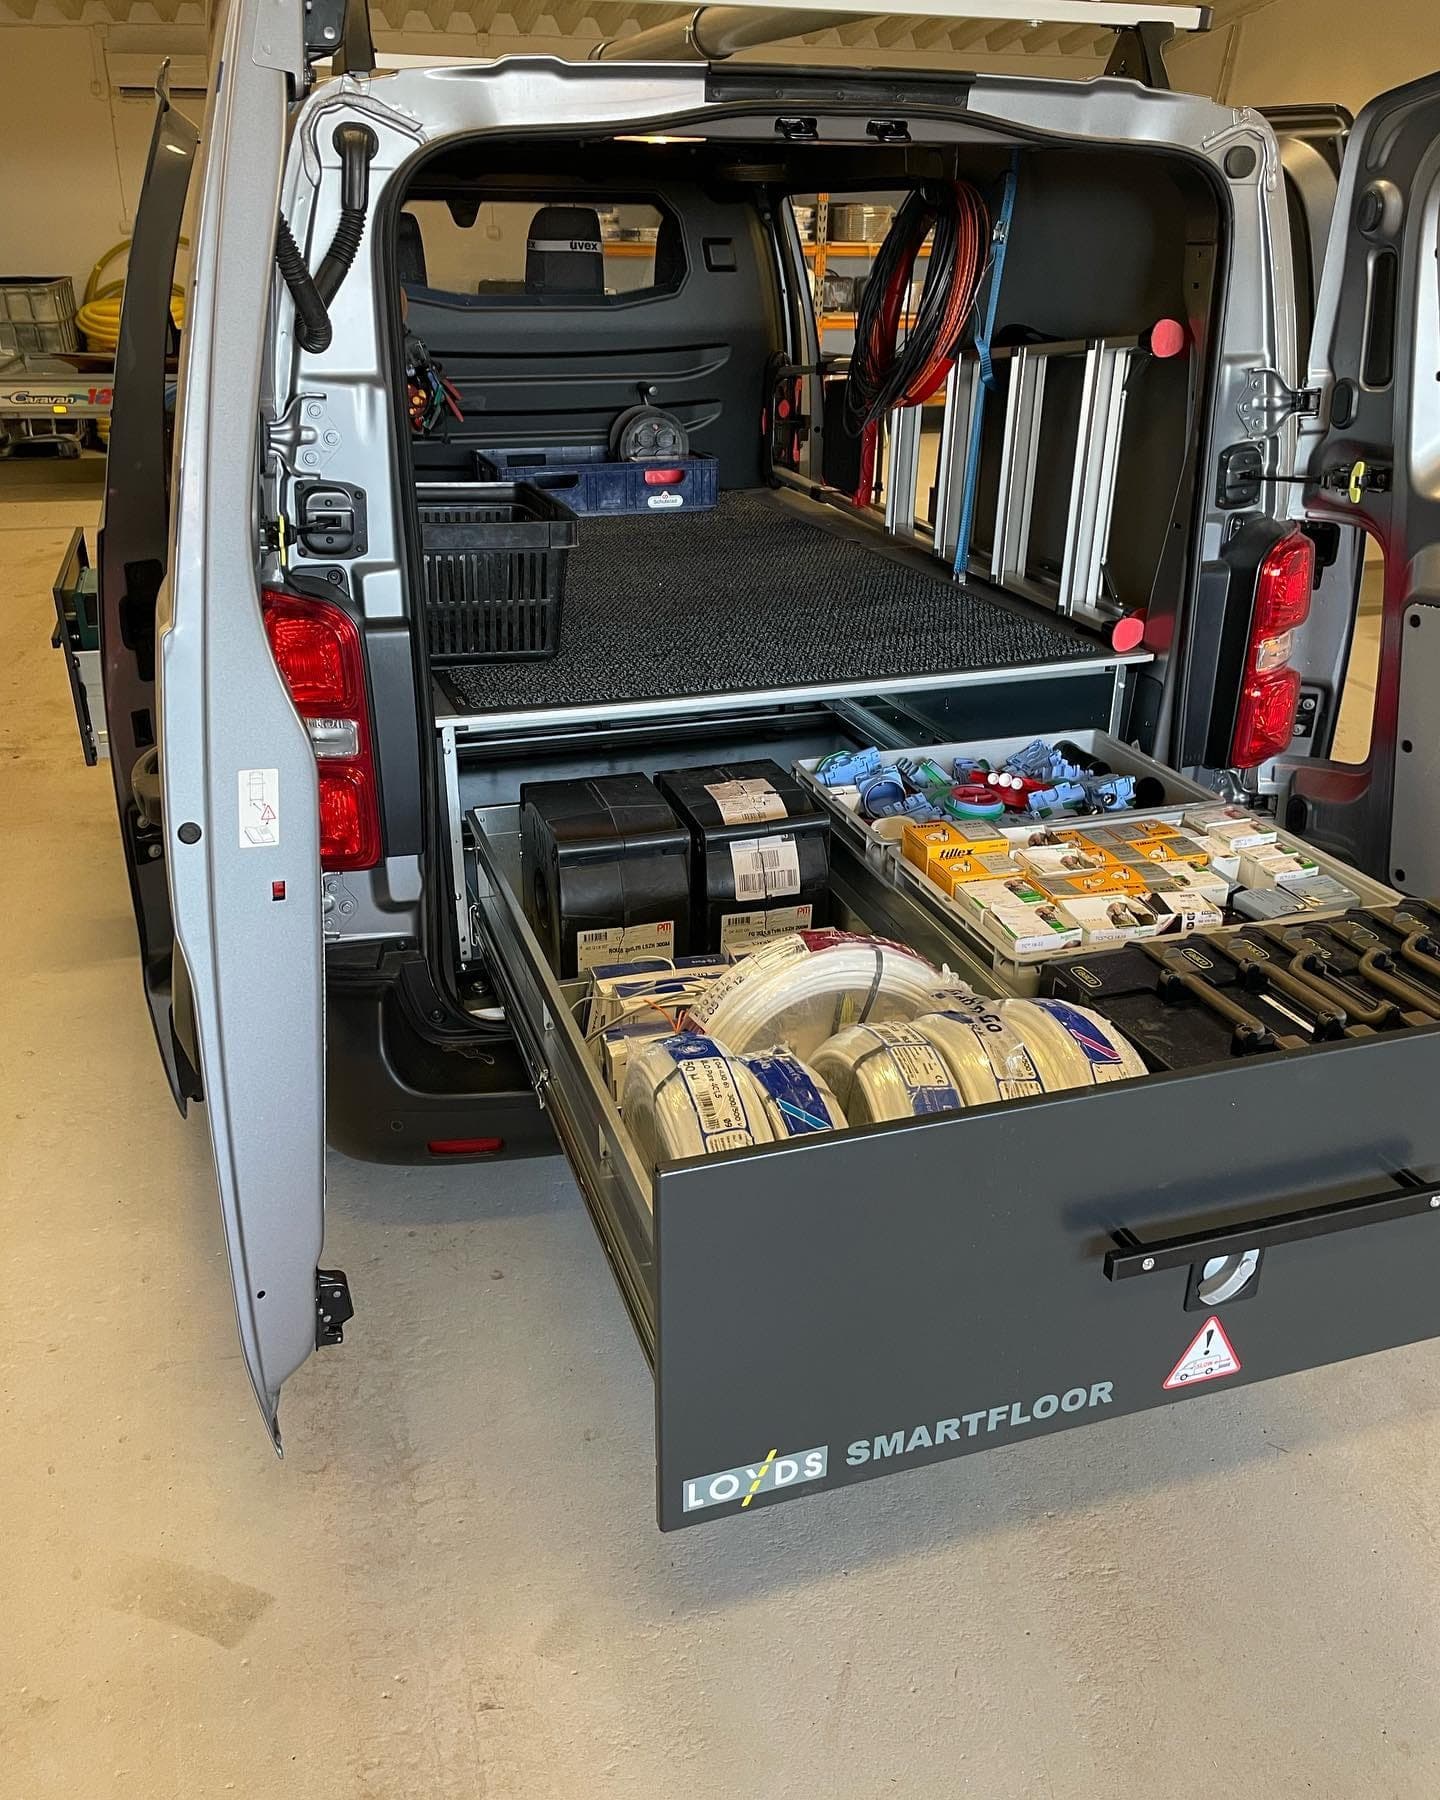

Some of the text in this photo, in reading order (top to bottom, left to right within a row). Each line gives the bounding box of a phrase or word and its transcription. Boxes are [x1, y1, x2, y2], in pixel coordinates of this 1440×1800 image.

[569, 240, 598, 251] uvex
[9, 391, 77, 405] Caravan
[939, 847, 976, 860] tillex
[687, 1381, 1114, 1508] LOYDS SMARTFLOOR
